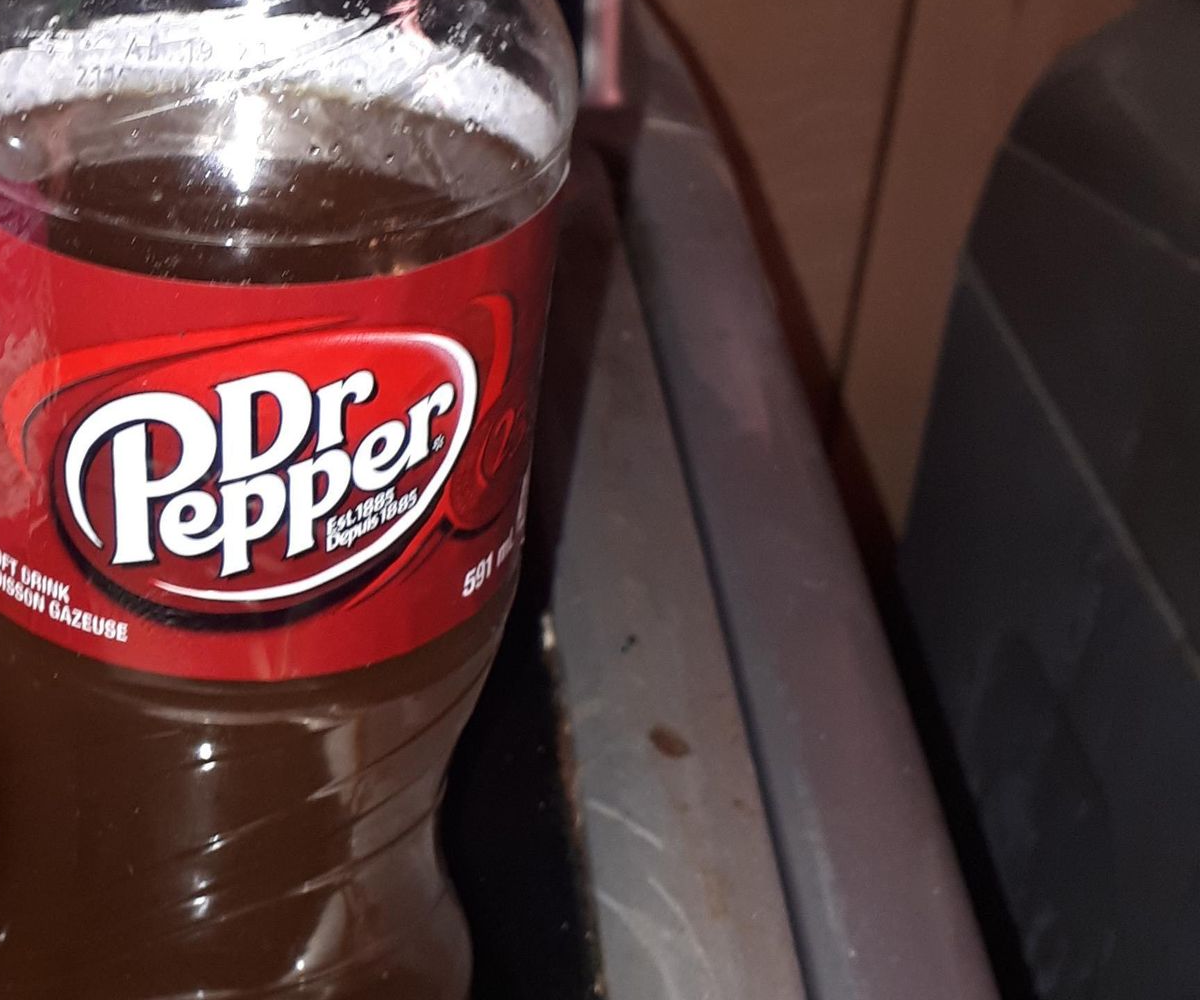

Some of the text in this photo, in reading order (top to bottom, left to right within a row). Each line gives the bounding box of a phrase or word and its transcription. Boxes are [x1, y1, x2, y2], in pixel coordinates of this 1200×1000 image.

[216, 369, 377, 482] Dr
[64, 381, 456, 579] Pepper
[325, 487, 419, 553] Depuis 1885
[20, 564, 71, 604] DRINK
[461, 550, 494, 598] 591
[48, 600, 129, 643] GAZEUSE
